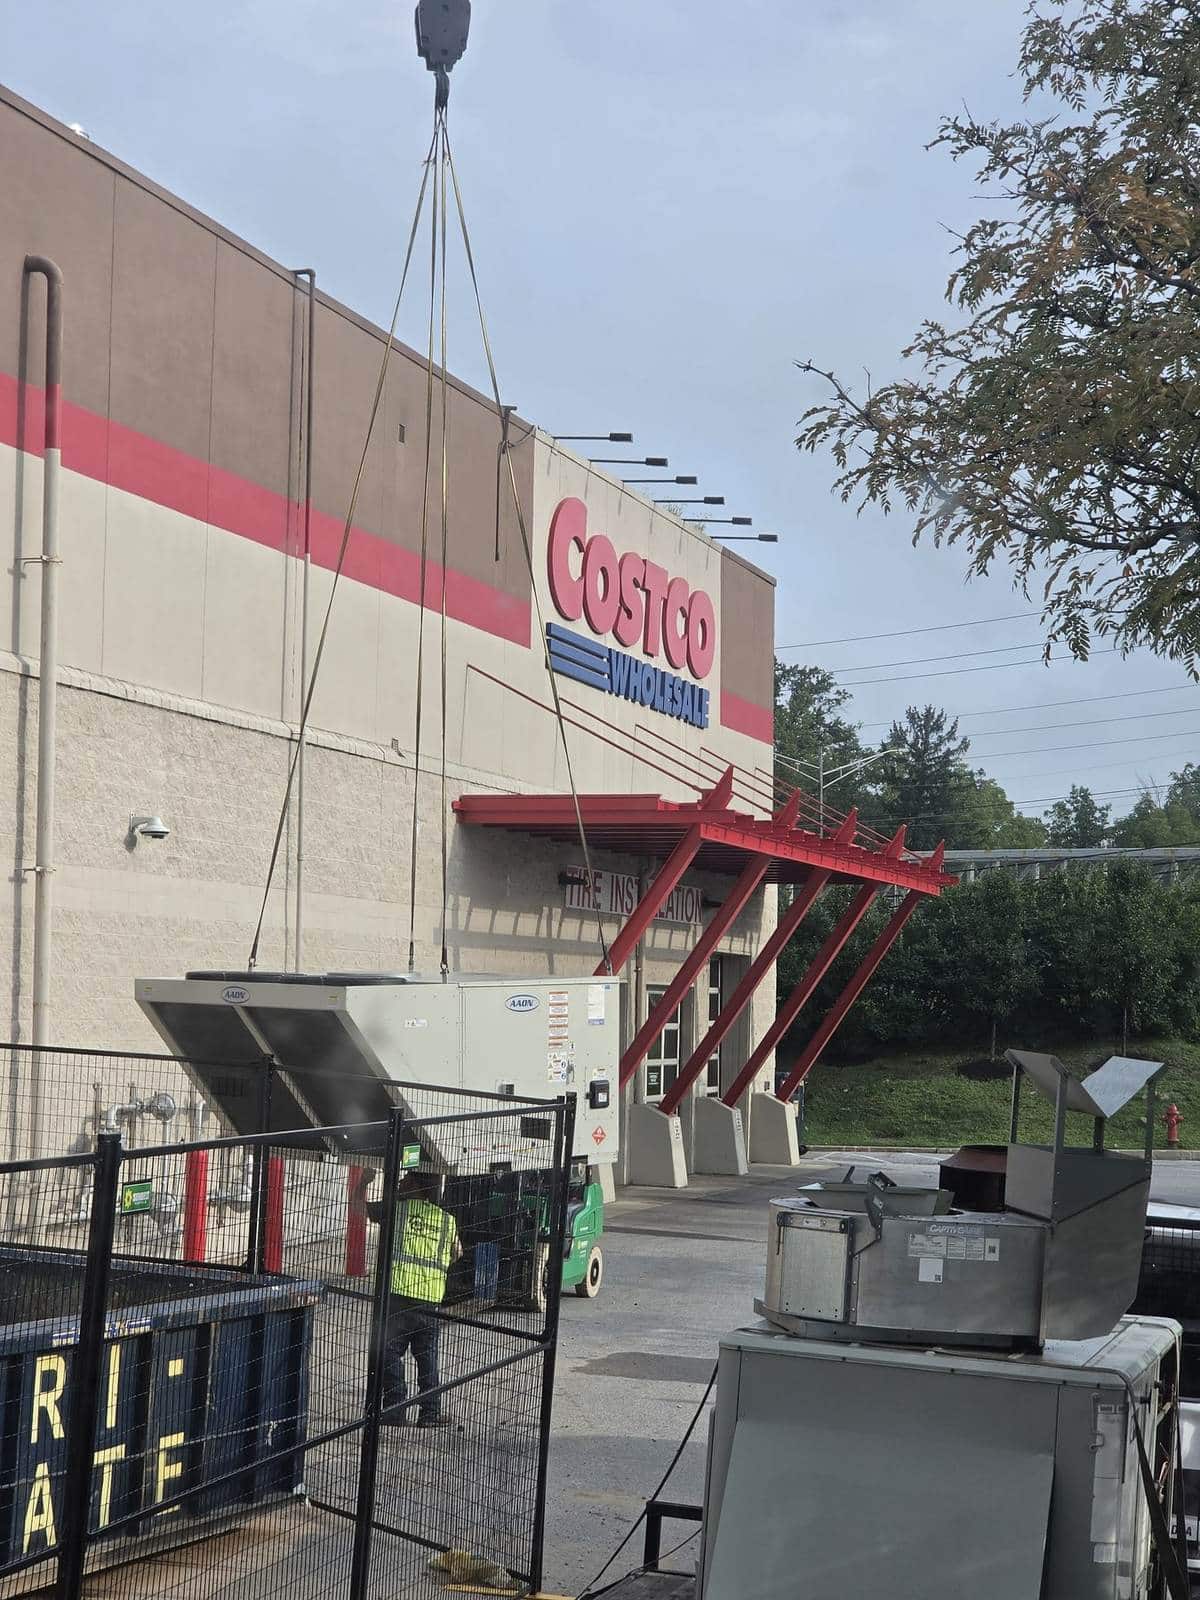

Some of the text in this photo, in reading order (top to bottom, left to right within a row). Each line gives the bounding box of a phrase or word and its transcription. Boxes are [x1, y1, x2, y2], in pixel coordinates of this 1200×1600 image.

[547, 497, 715, 679] COSTCO
[608, 648, 710, 729] WHOLESALE
[566, 867, 603, 909] TIRE
